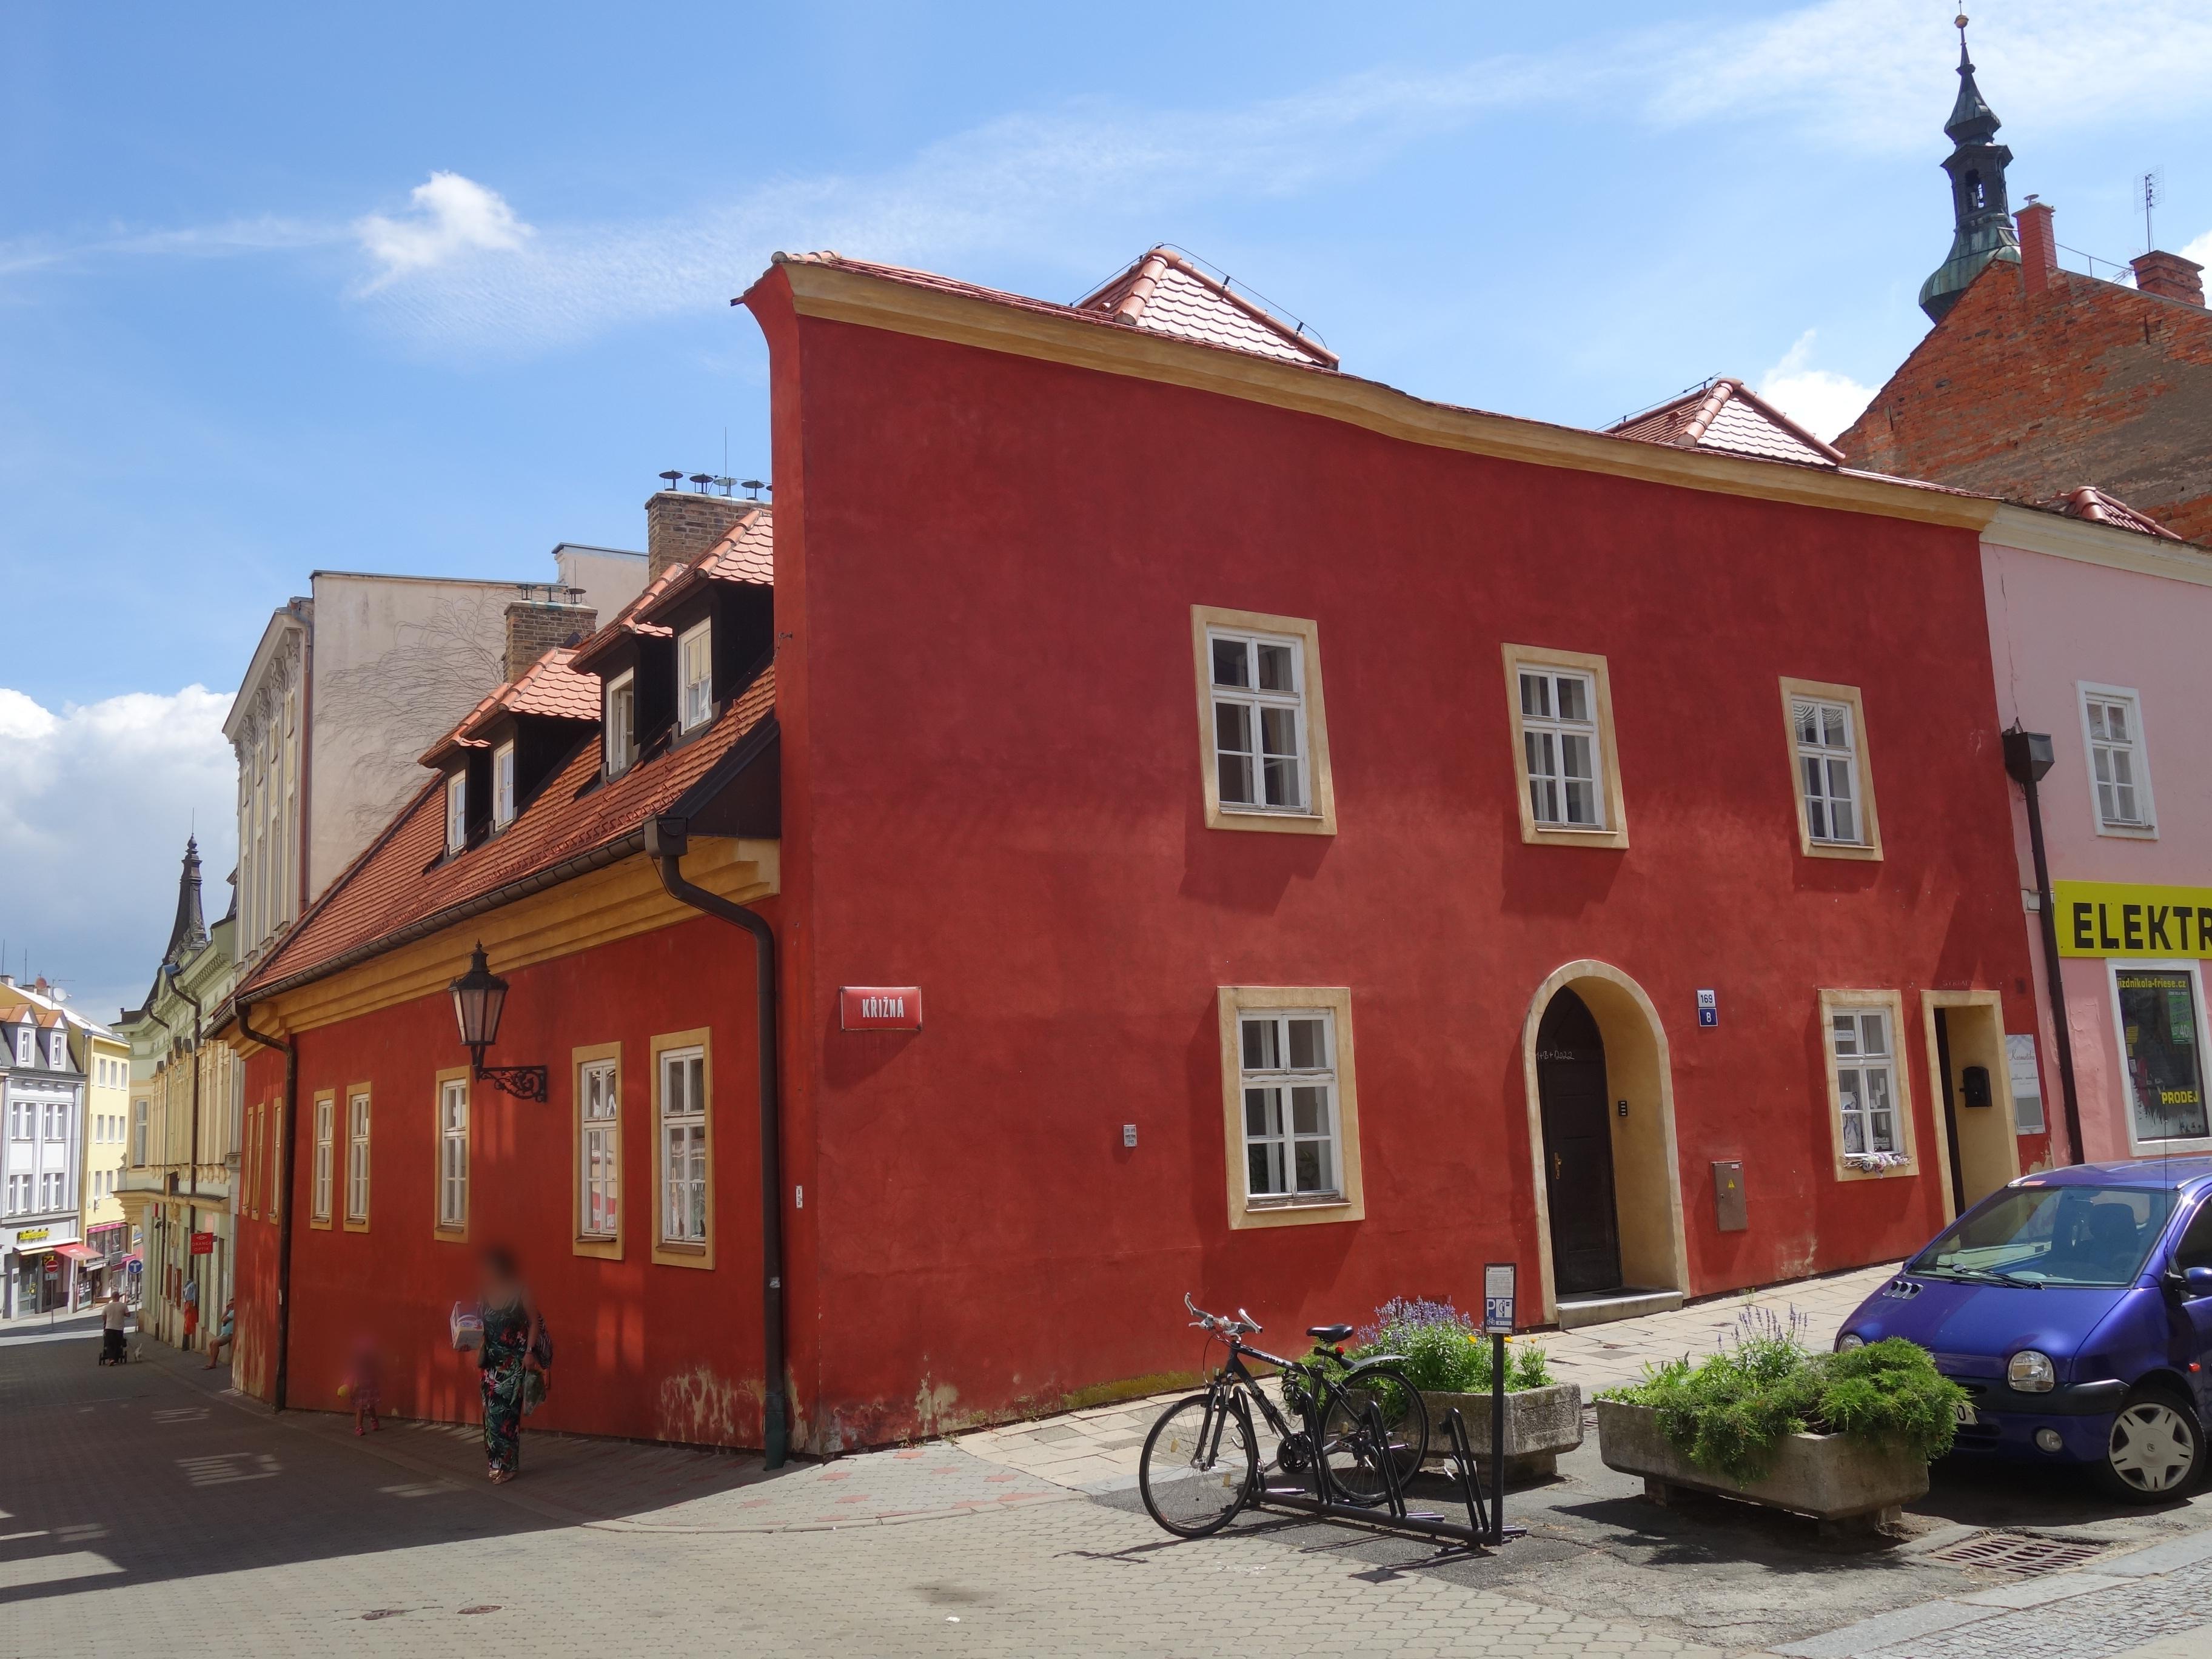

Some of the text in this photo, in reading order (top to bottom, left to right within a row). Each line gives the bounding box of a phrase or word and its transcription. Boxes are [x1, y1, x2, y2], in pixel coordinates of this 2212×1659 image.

[2073, 902, 2212, 951] ELEKTR
[862, 996, 904, 1018] KŘIŽNÁ
[1700, 994, 1713, 1004] 169
[1706, 1011, 1712, 1023] 8
[2162, 1090, 2198, 1105] PRODEJ
[1487, 1299, 1496, 1316] P
